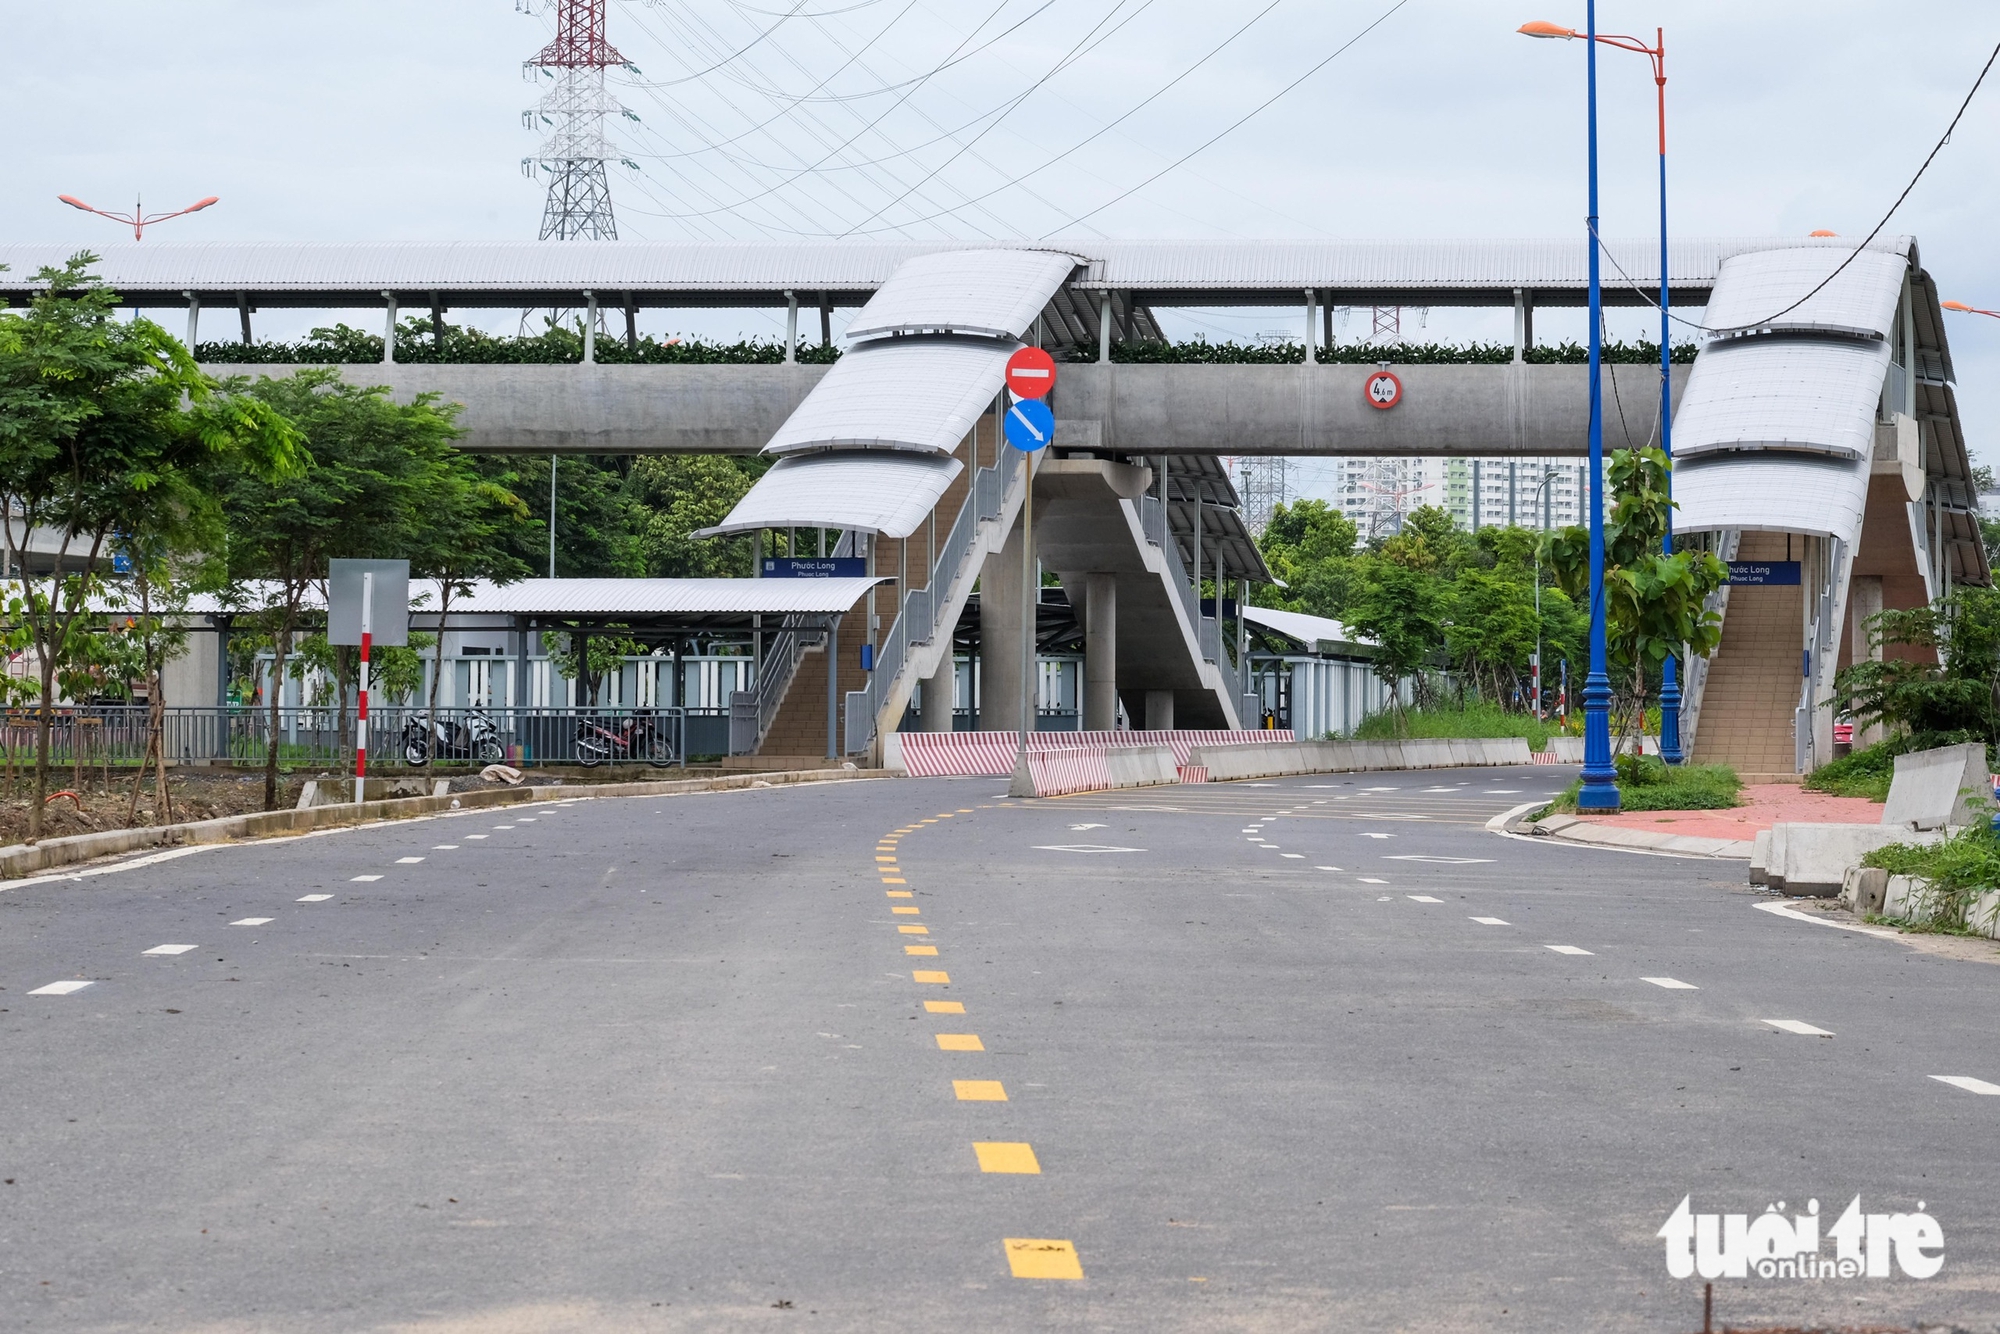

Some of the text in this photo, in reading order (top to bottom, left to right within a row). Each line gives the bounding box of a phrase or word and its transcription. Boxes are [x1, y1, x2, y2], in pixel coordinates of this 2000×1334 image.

[791, 561, 836, 571] Phước Long
[1729, 565, 1770, 575] hước Long
[1749, 575, 1764, 583] Long
